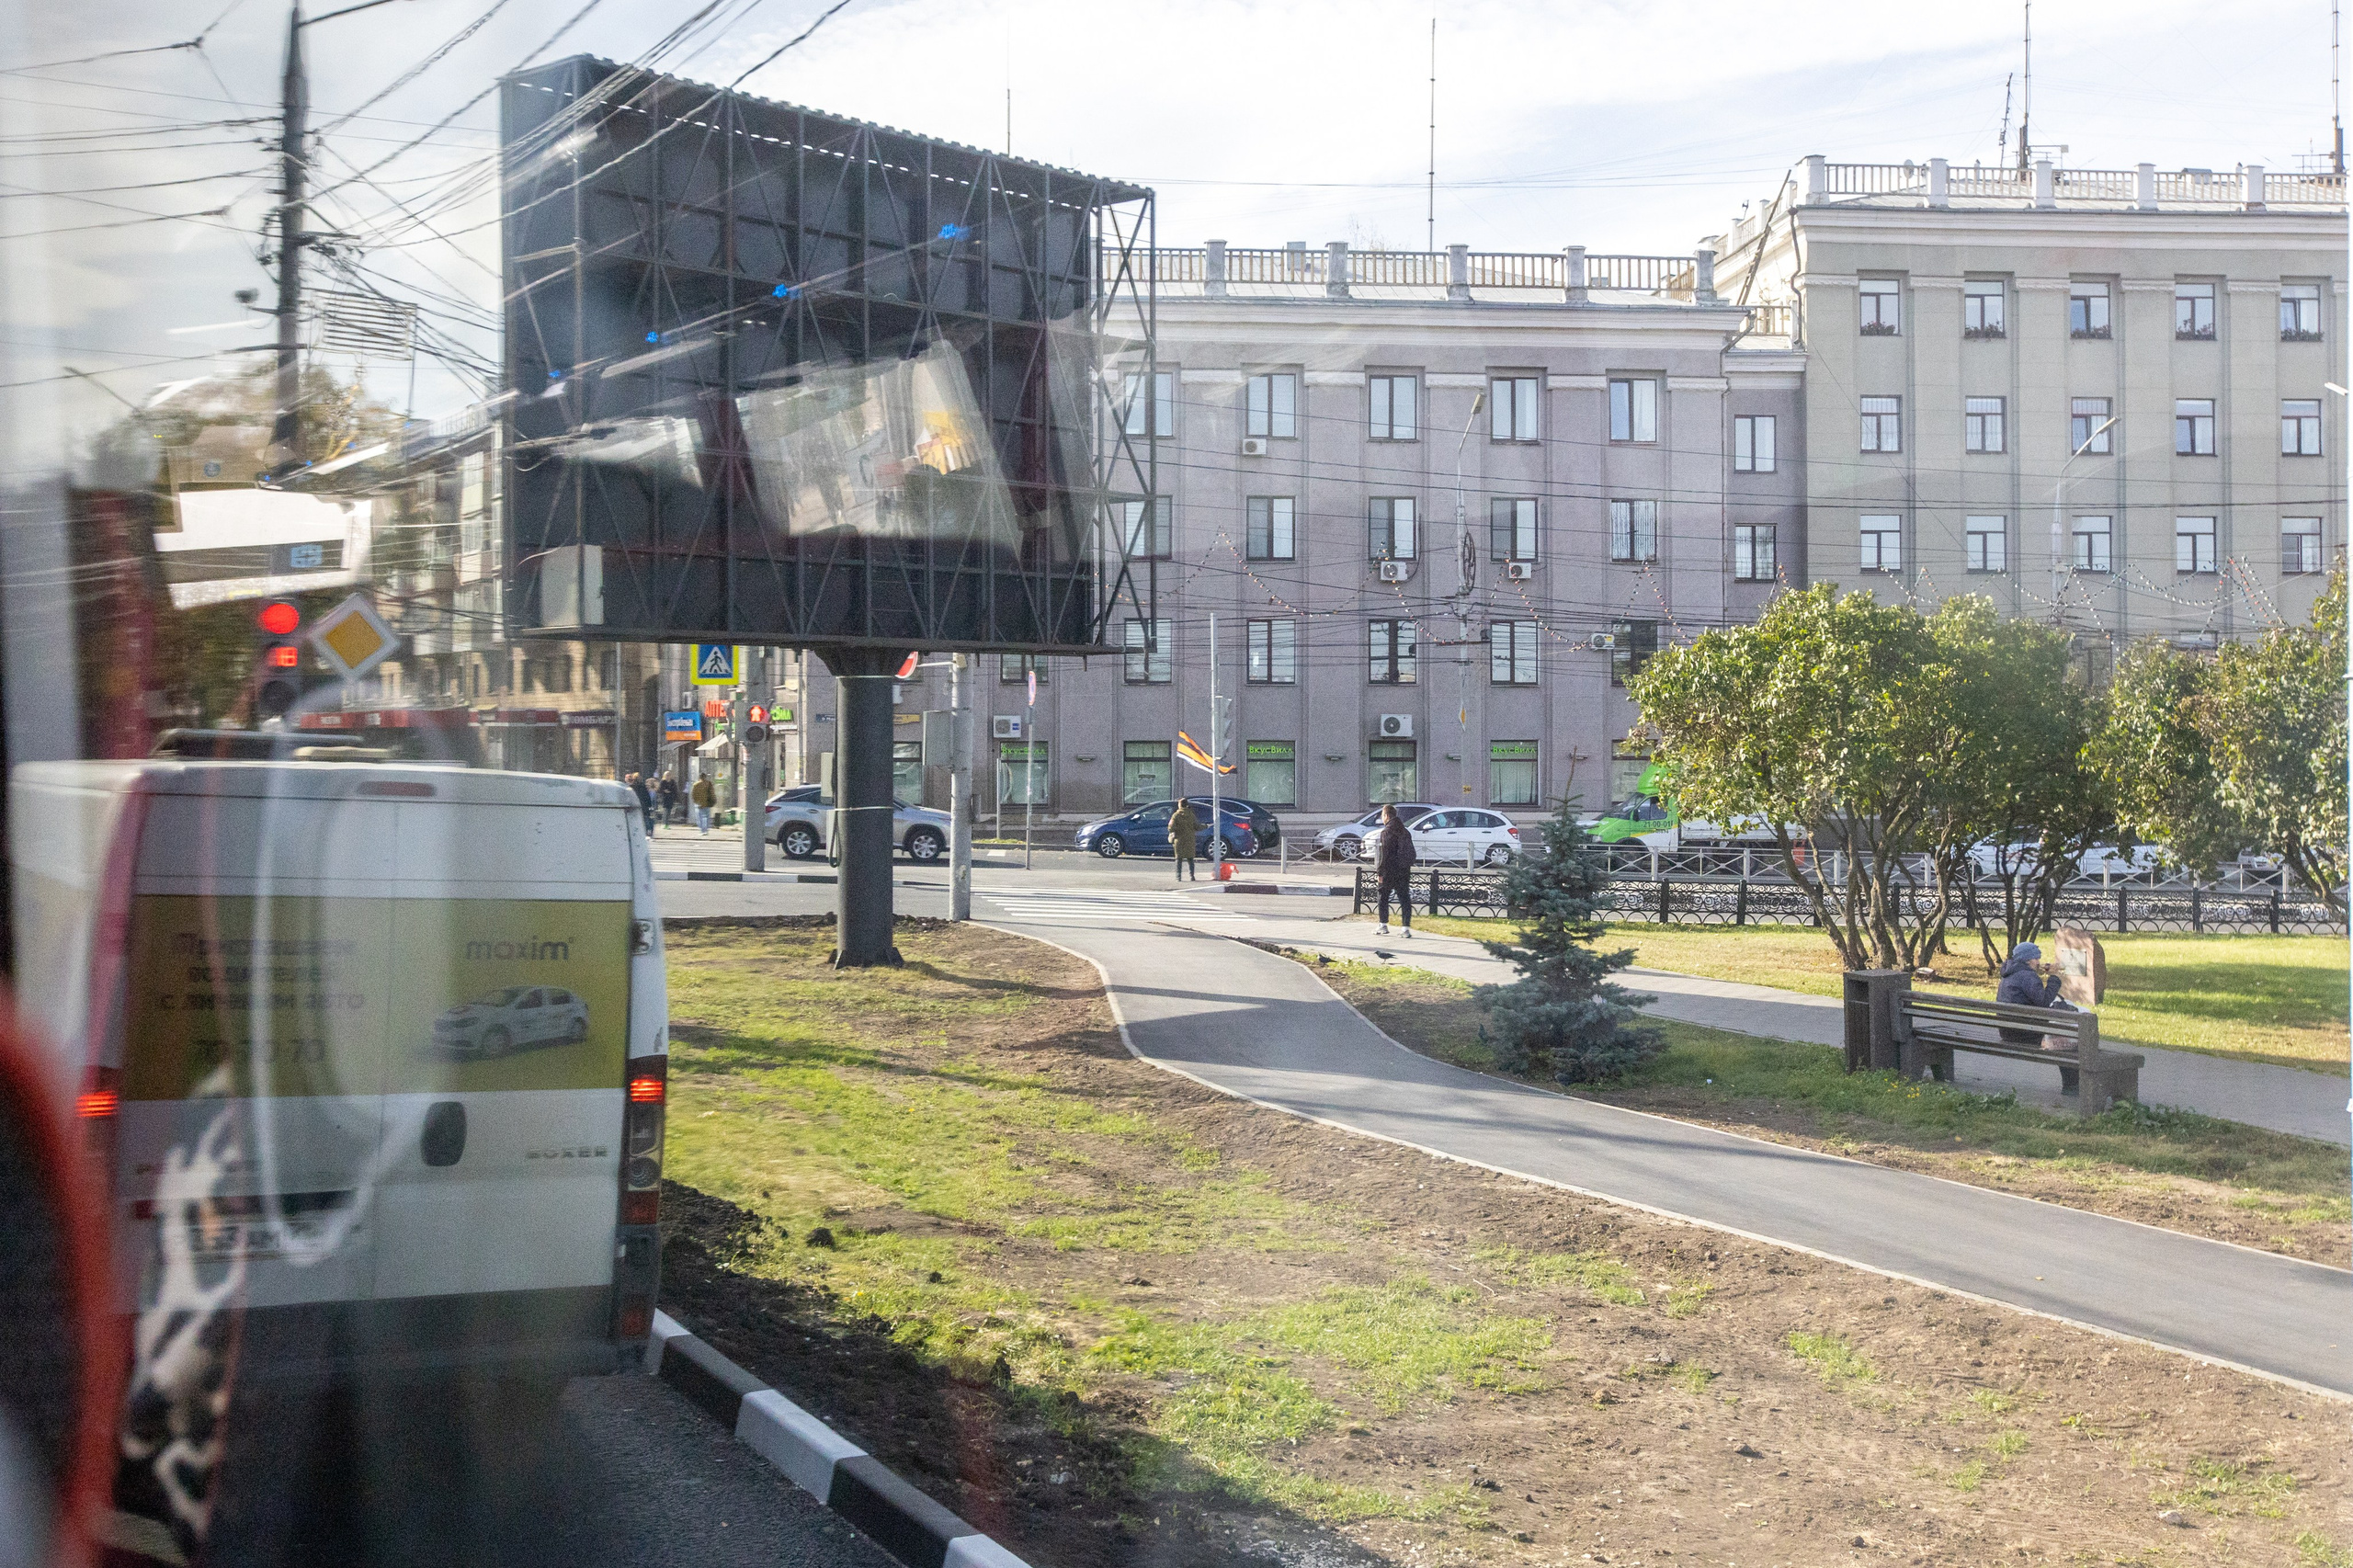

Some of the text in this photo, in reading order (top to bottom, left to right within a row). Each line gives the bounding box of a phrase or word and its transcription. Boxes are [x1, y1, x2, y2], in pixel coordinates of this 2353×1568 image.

[1002, 745, 1046, 755] ВкусВлл
[1248, 745, 1293, 755] ВкусВилл
[1493, 745, 1536, 755] ВкусВилл
[466, 936, 569, 960] maxim
